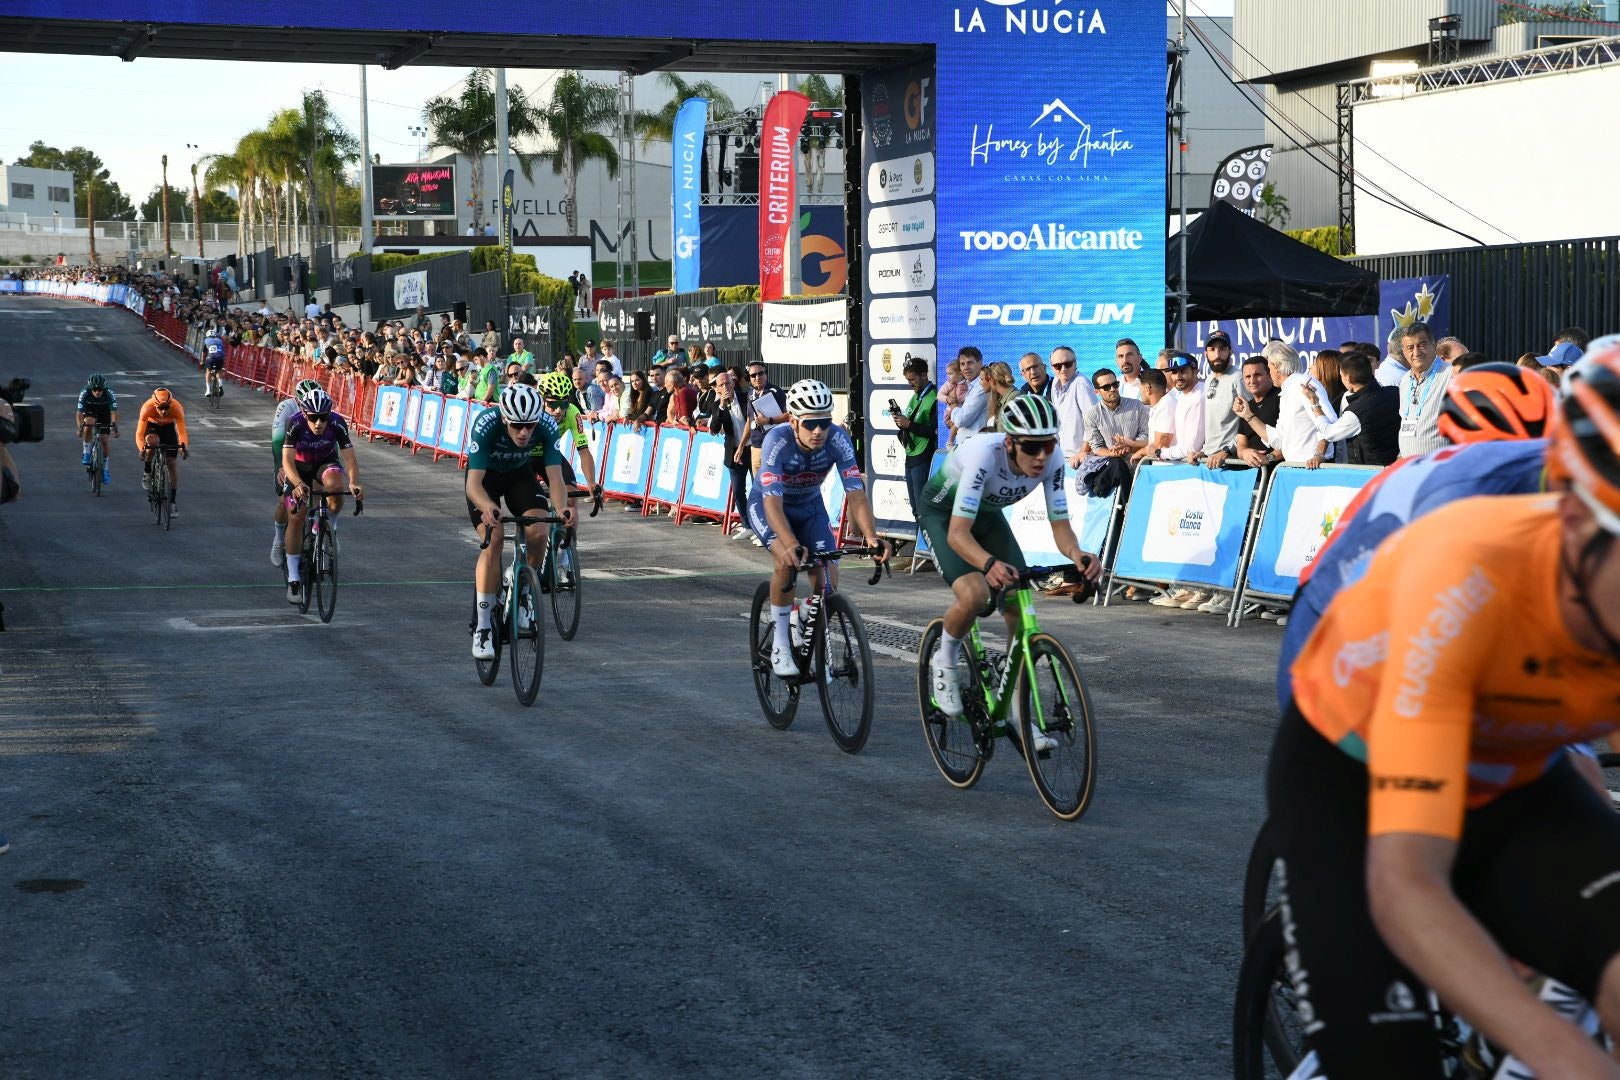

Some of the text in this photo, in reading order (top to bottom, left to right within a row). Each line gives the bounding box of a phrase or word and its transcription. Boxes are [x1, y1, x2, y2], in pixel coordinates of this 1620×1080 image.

[954, 8, 986, 33] LA
[970, 124, 1032, 167] Homes
[1037, 133, 1064, 166] by
[768, 126, 791, 224] CRITERIUM
[1004, 174, 1041, 182] CASAS
[1079, 174, 1109, 182] ALMA
[683, 201, 692, 218] LA
[960, 223, 1143, 250] TODOAlicante
[967, 303, 1136, 326] PODIUM
[1196, 318, 1219, 348] LA
[475, 410, 497, 434] KERN
[1180, 519, 1202, 529] Blanca
[1185, 509, 1204, 519] Costa
[800, 594, 821, 657] CANYON
